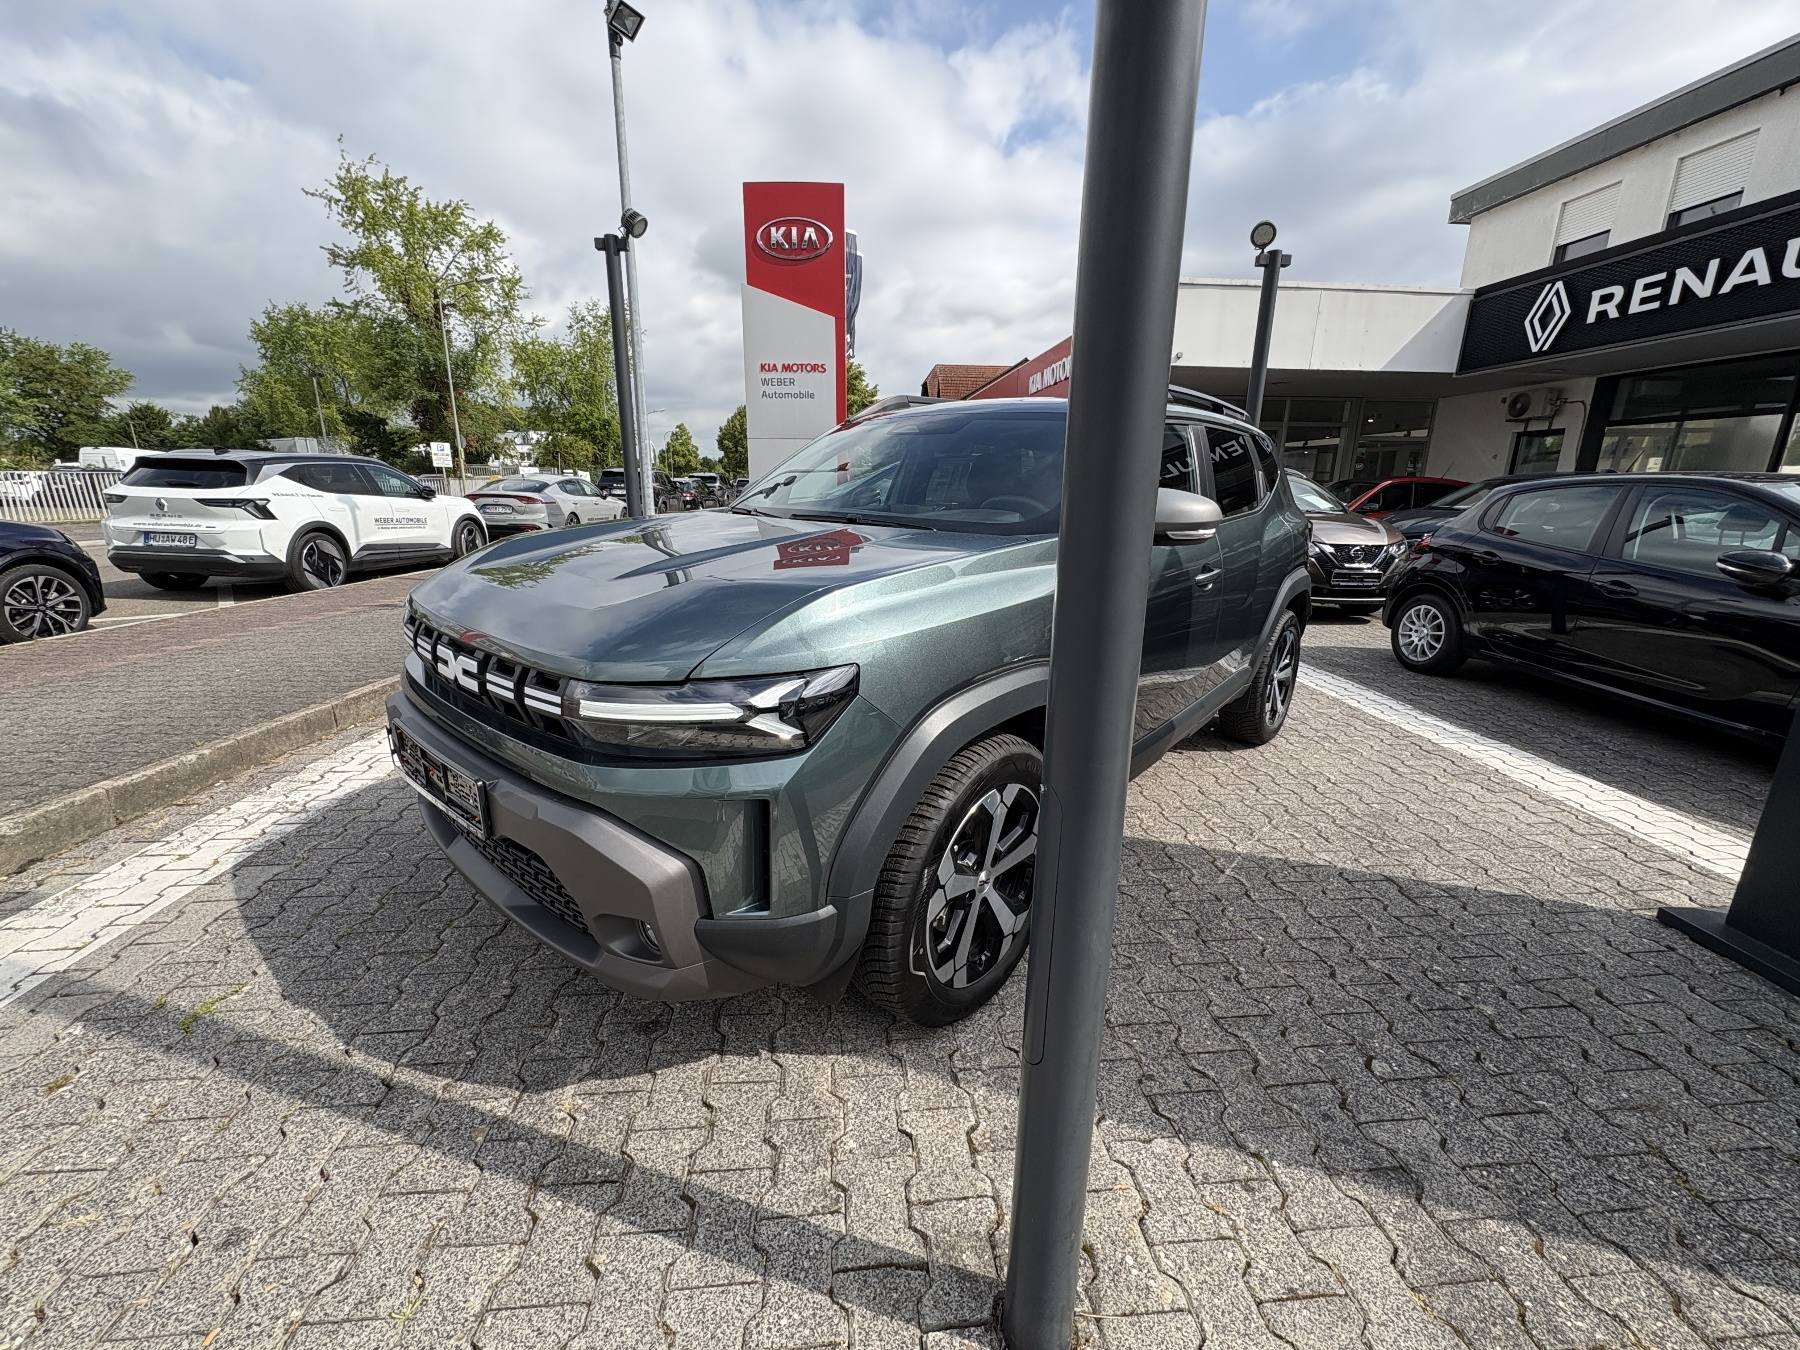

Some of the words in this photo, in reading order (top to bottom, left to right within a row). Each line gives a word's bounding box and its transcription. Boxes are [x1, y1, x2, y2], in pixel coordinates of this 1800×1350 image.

[769, 226, 820, 249] KIA
[760, 362, 779, 373] KIA
[781, 362, 827, 374] MOTORS
[760, 377, 796, 387] WEBER
[761, 390, 815, 400] Automobile
